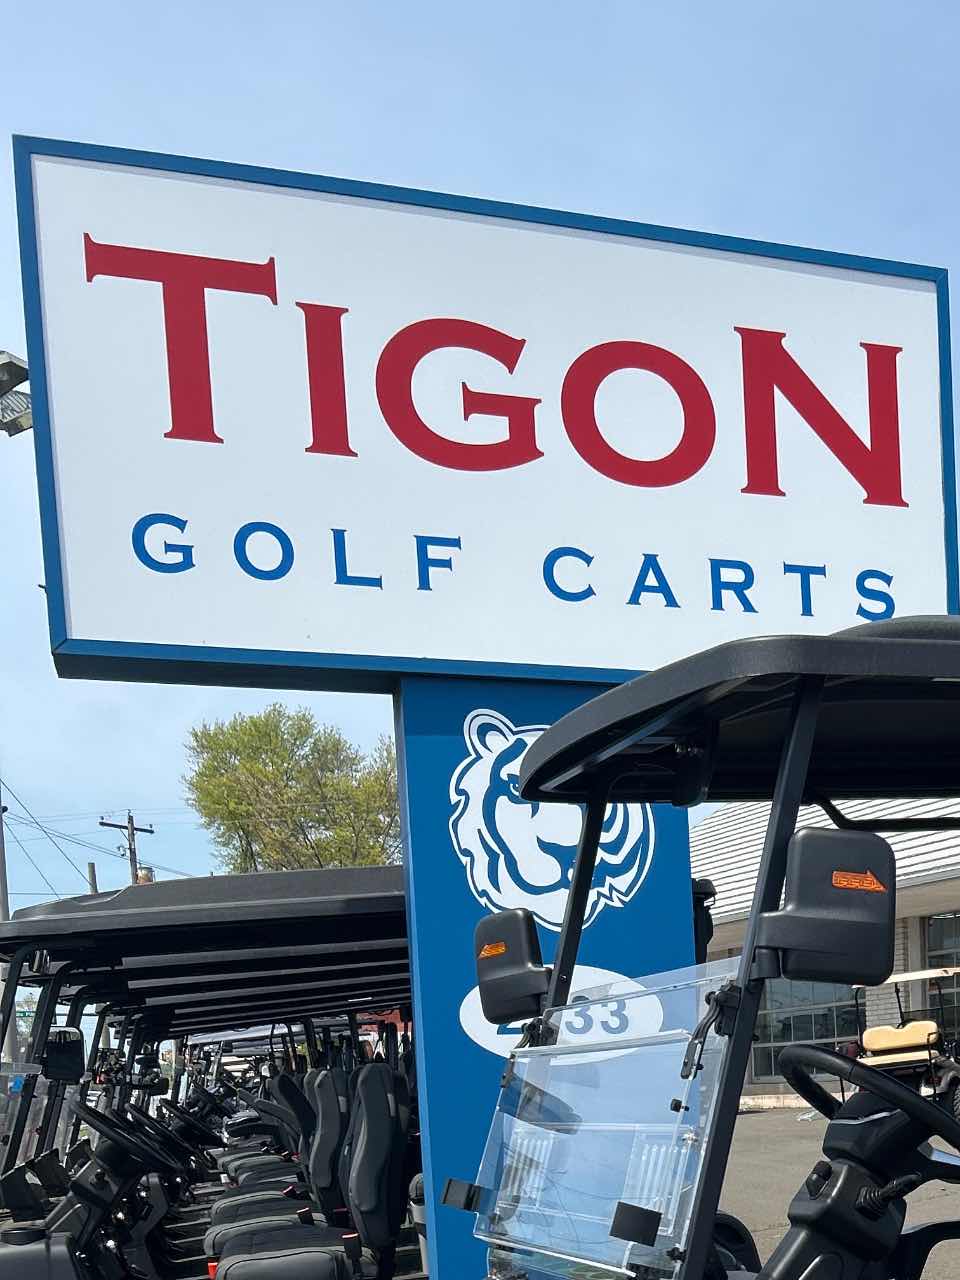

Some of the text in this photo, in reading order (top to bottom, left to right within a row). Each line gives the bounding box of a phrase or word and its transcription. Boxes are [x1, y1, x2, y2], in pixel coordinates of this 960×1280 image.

[83, 232, 909, 508] TIGON
[132, 513, 897, 622] GOLF CARTS
